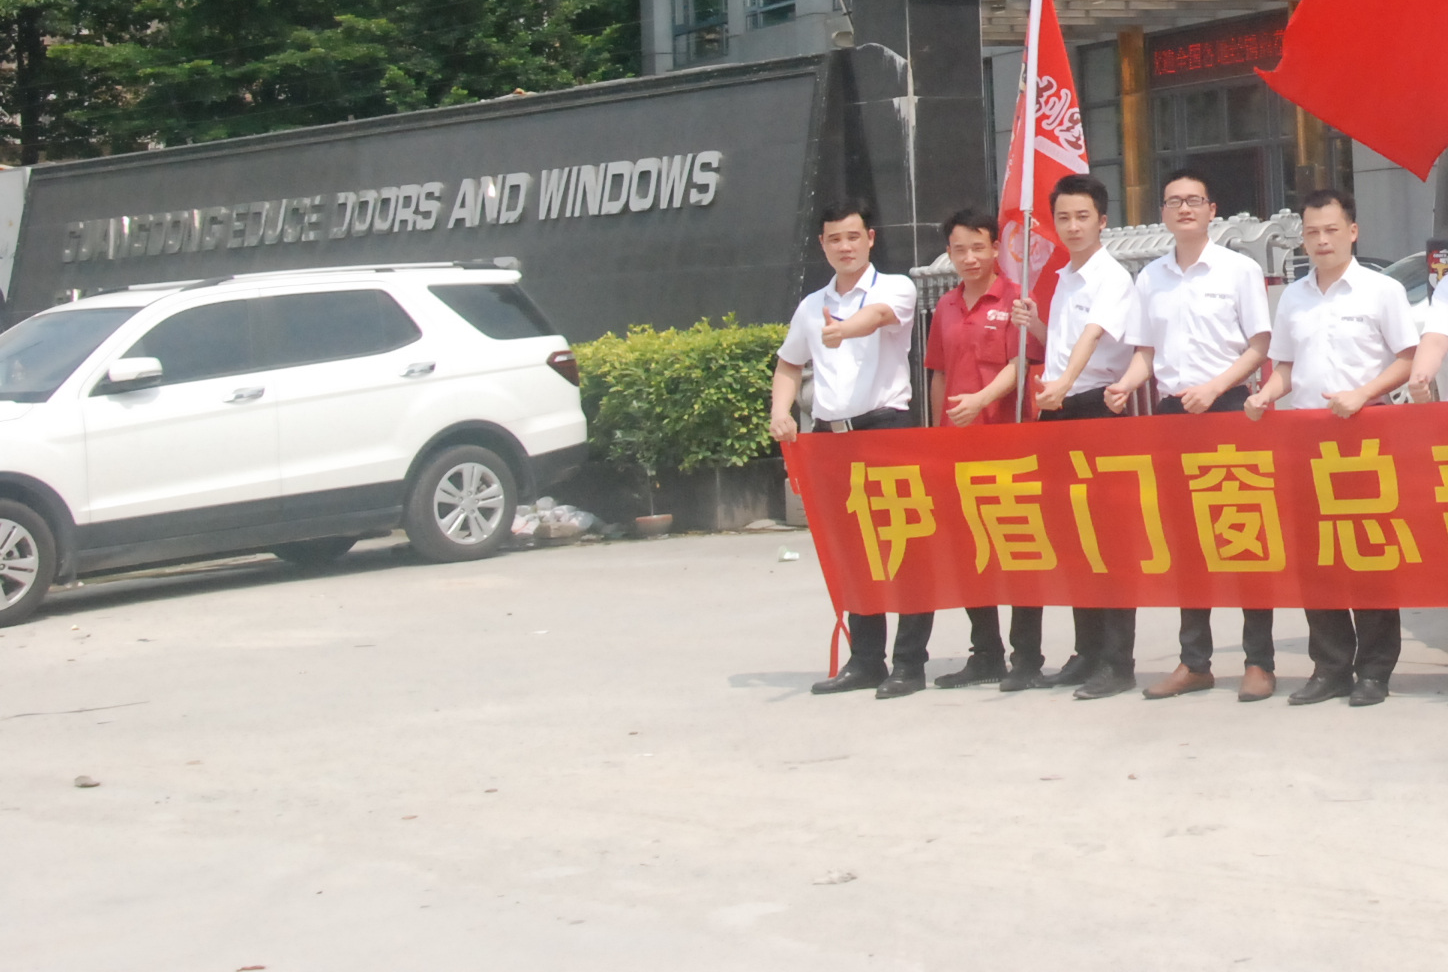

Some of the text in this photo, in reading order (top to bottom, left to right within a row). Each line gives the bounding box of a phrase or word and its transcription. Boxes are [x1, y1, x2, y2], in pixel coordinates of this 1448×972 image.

[227, 194, 328, 249] EDUCE
[329, 181, 445, 239] DOORS
[447, 172, 531, 229] AND
[539, 150, 722, 220] WINDOWS
